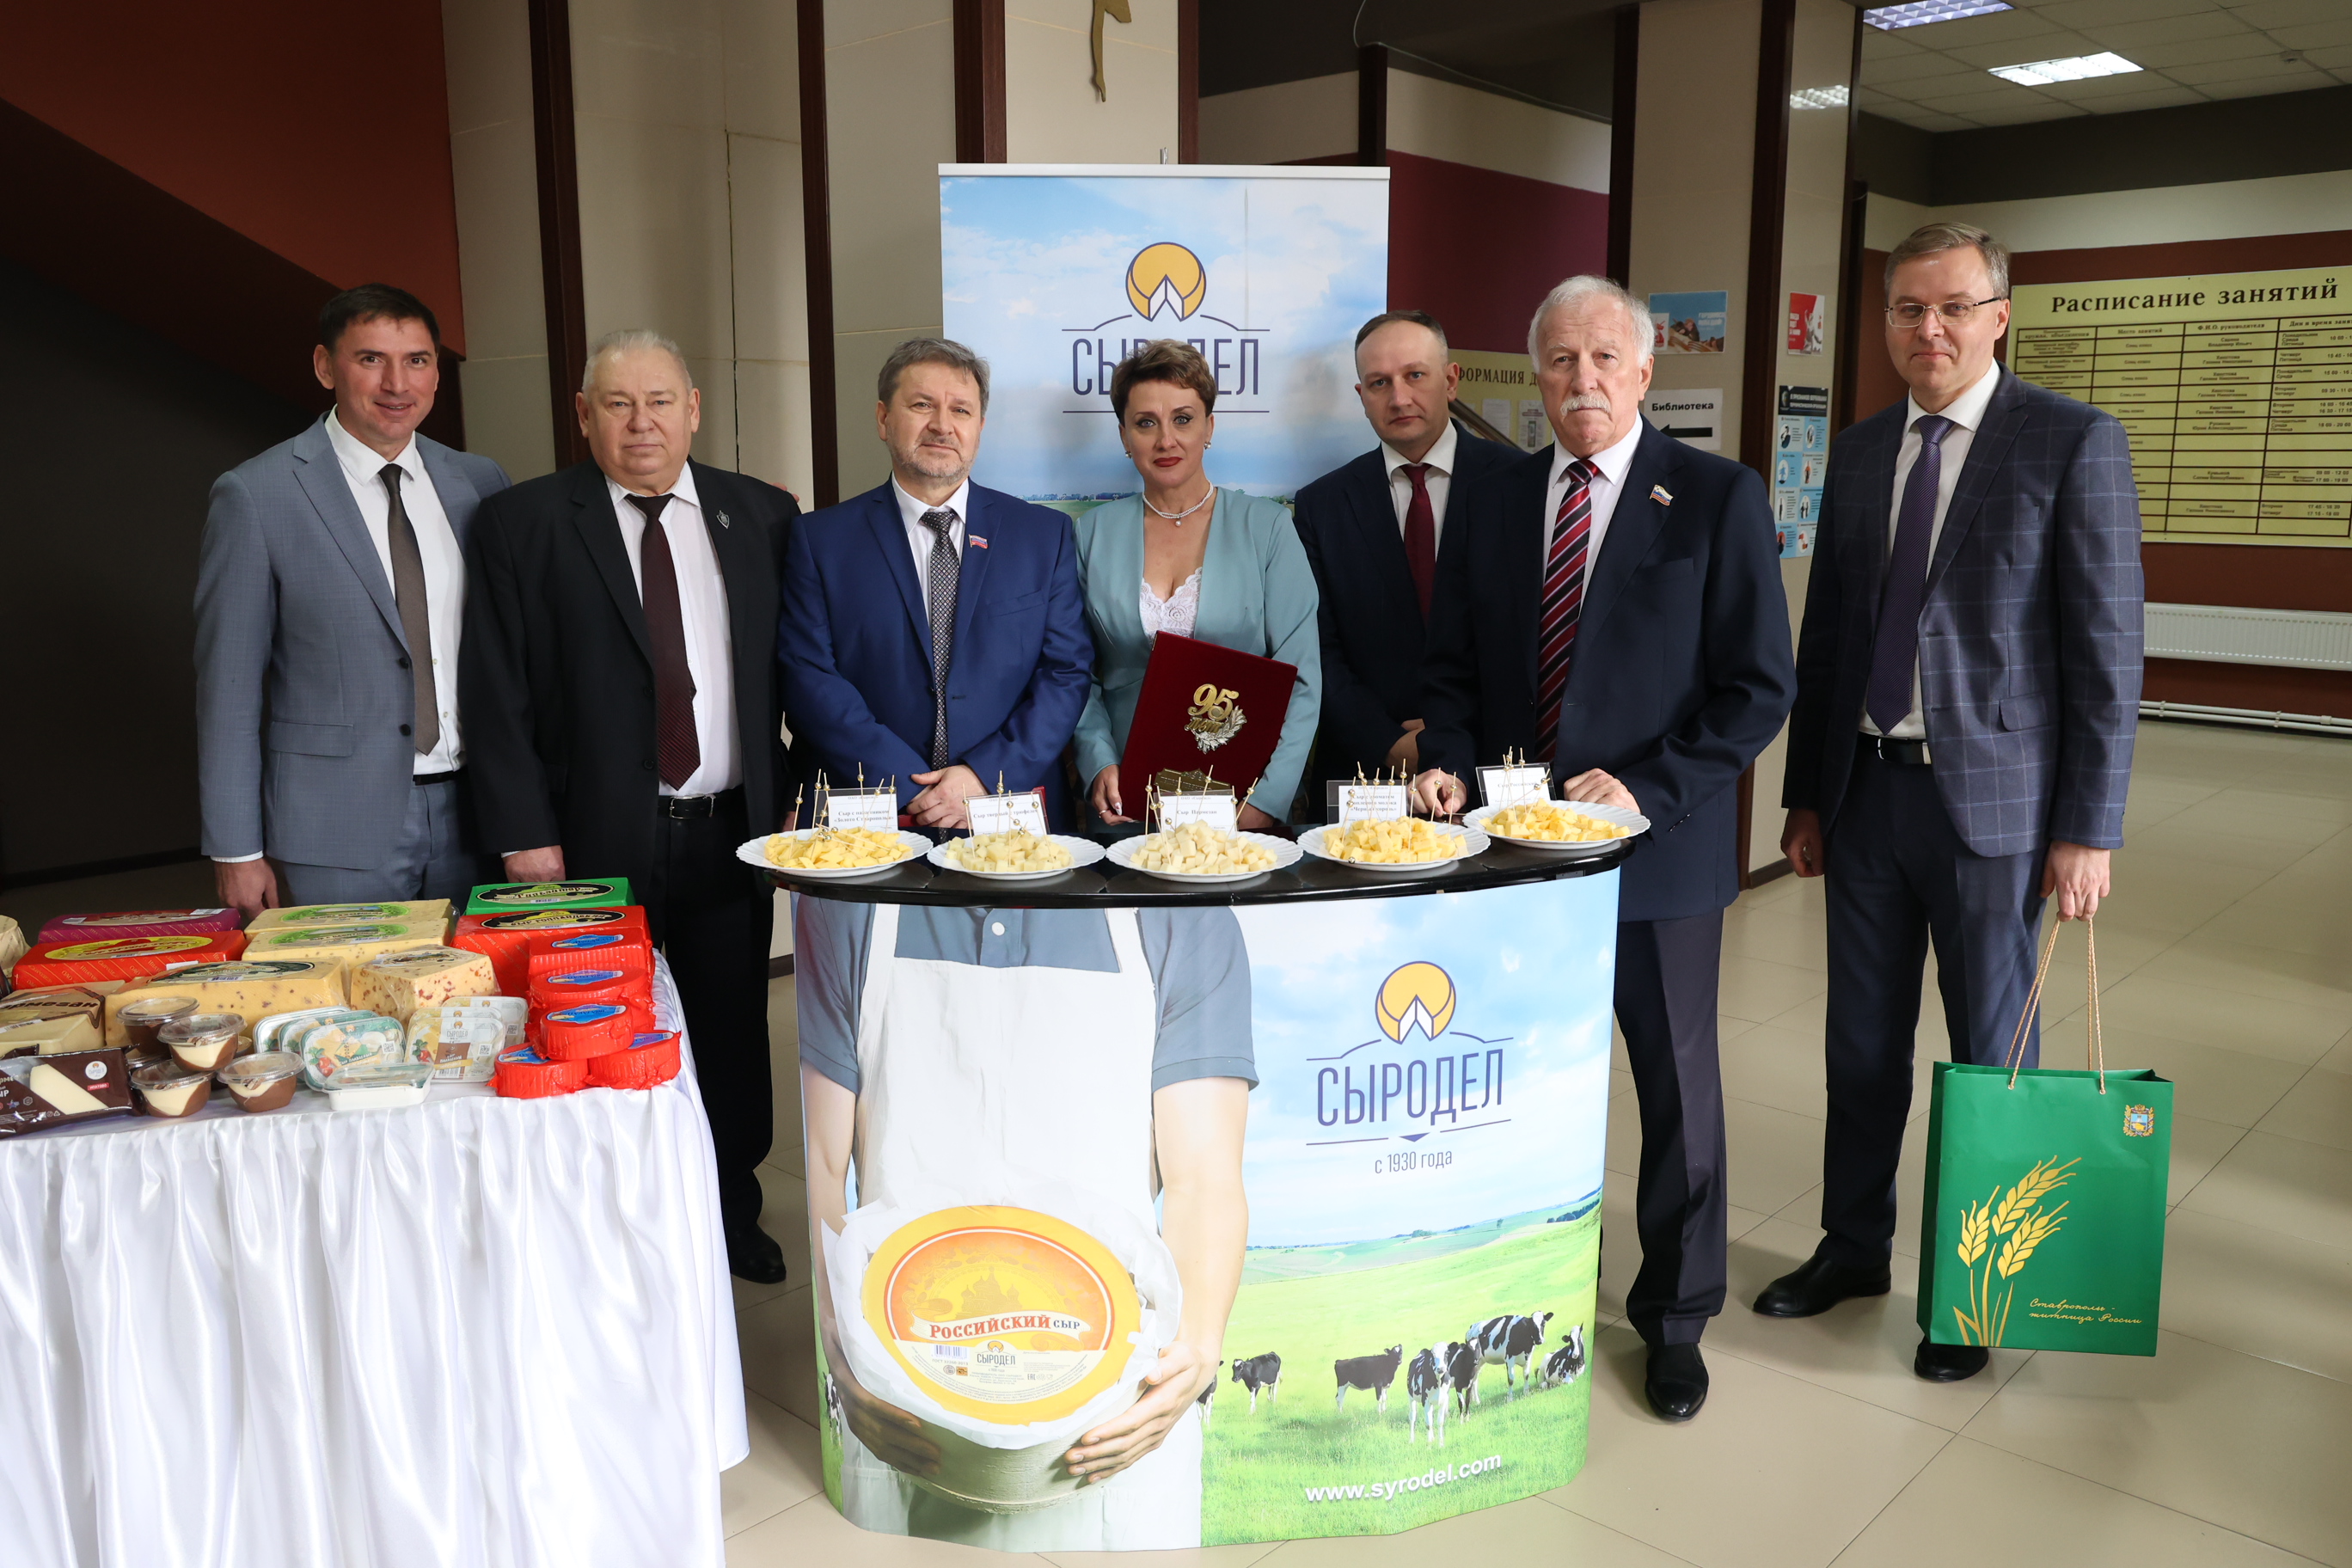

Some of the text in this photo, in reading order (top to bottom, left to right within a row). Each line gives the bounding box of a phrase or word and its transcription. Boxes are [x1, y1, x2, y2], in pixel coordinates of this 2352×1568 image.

[2051, 278, 2338, 314] Расписание занятий
[1073, 338, 1259, 395] СЫЕЛ
[1459, 367, 1525, 385] ФОРМАЦИЯ
[1651, 402, 1714, 412] Библиотека
[1187, 683, 1240, 720] 95
[1318, 1049, 1503, 1126] СЫРОДЕЛ
[1375, 1150, 1452, 1173] с 1930 года
[929, 1314, 1051, 1338] РОССИЙСКИЙ
[2098, 1314, 2142, 1324] России
[977, 1353, 1016, 1366] СЫРОДЕЛ
[1305, 1455, 1502, 1501] www.syrodel.com
